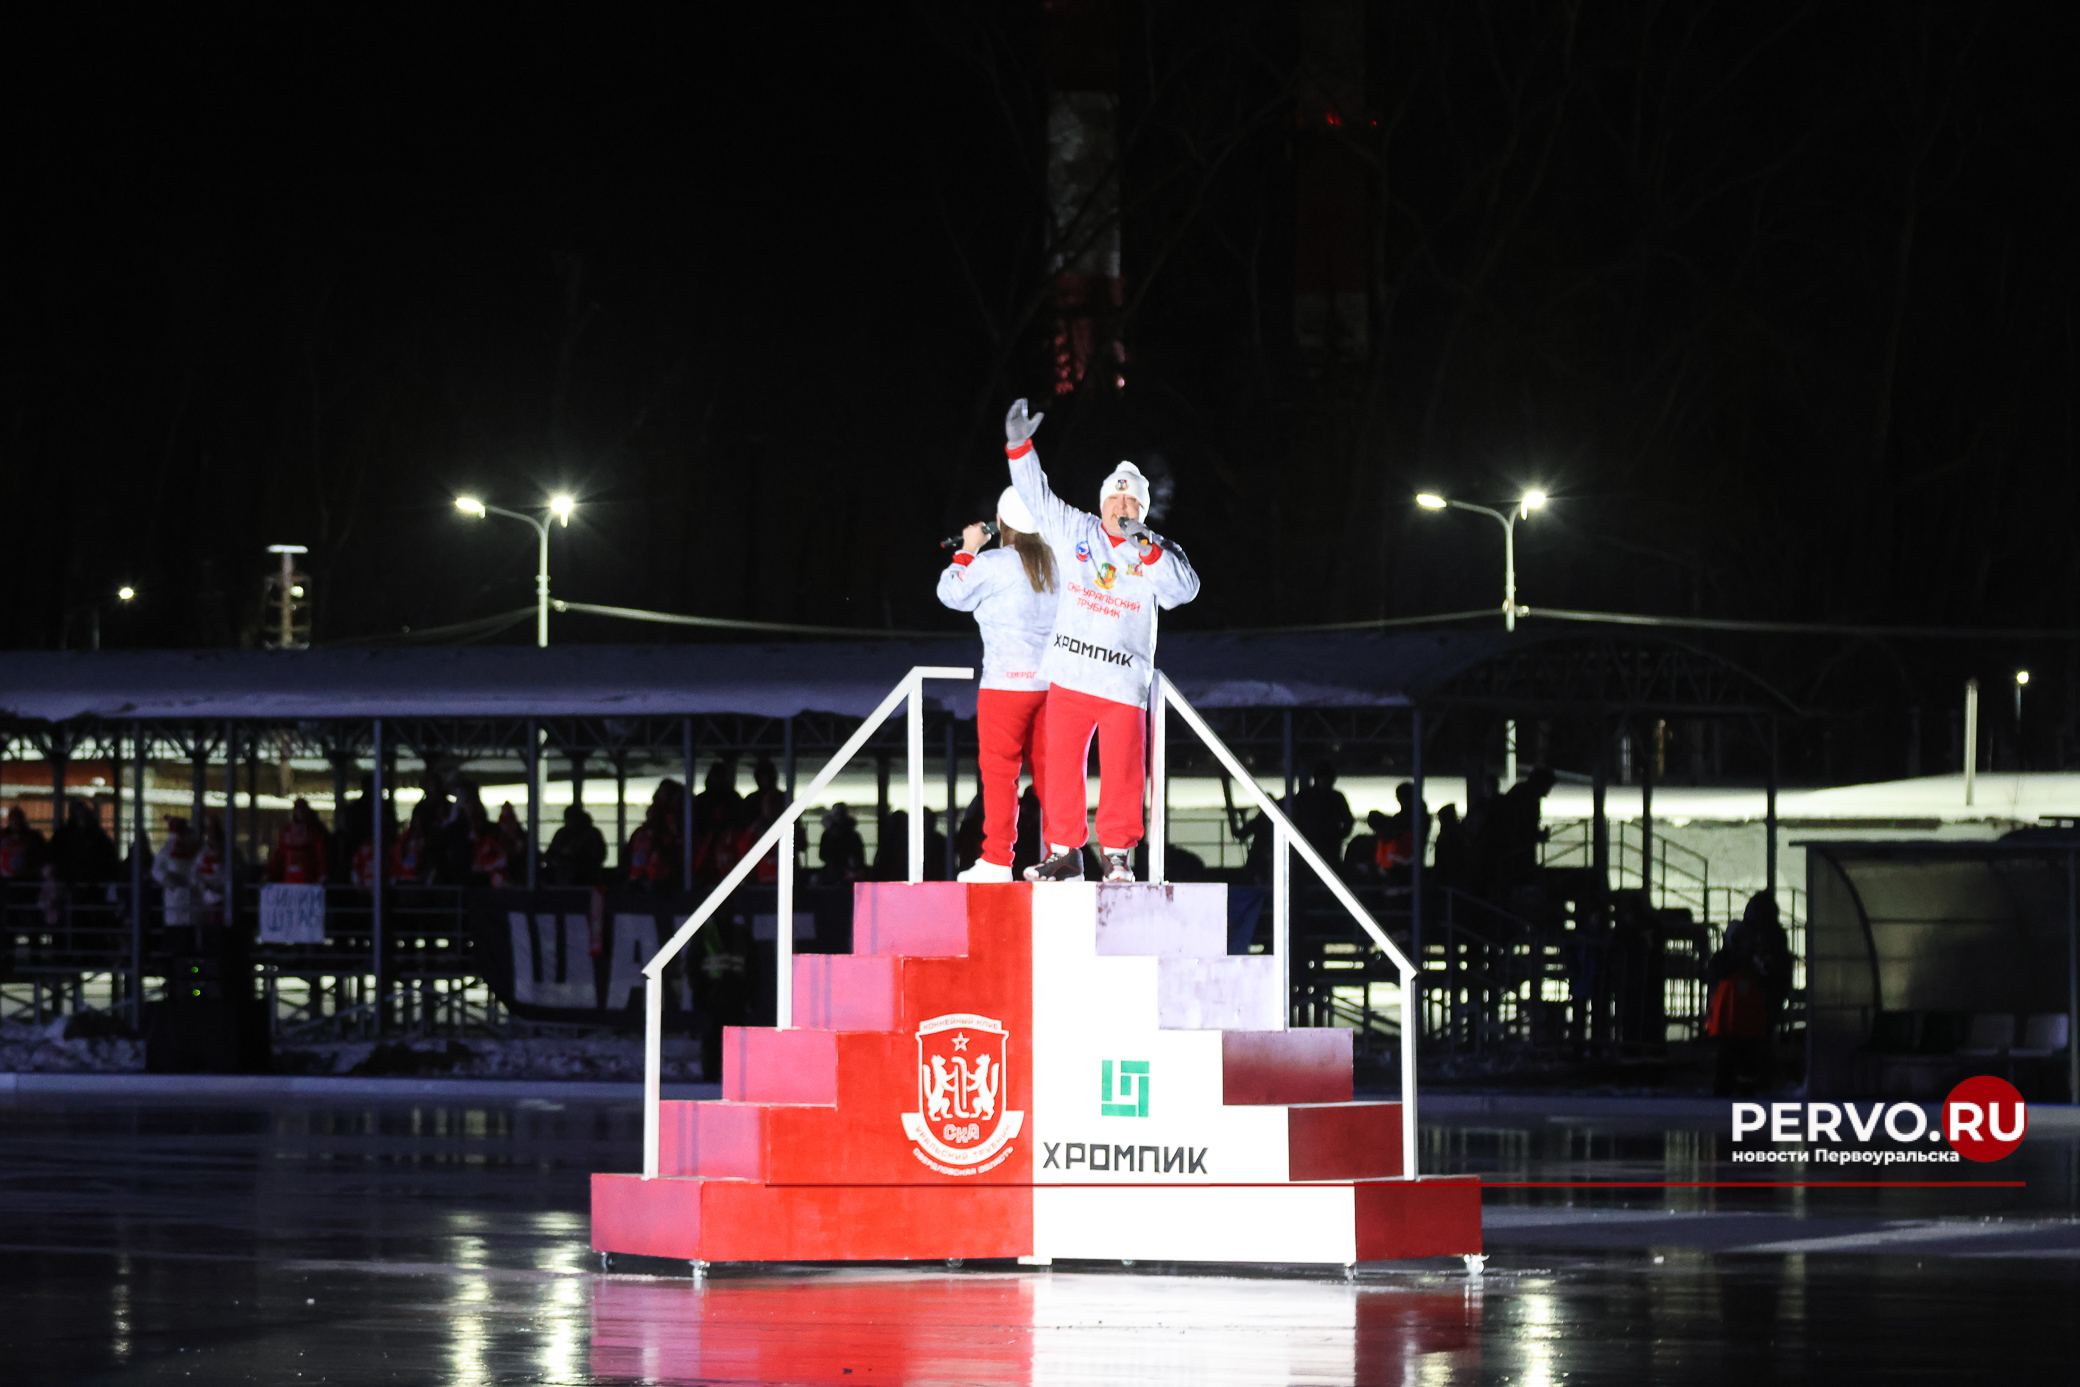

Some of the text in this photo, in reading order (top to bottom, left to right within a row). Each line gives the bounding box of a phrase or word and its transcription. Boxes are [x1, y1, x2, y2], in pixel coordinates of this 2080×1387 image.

[1077, 597, 1121, 619] ТРУБНИК
[1054, 633, 1134, 668] ХРОМПИК
[922, 1017, 999, 1030] ХОККЕЙНЫЙ КЛУБ
[915, 1124, 1012, 1161] УРАЛЬСКИЙ ТРУБНИК
[943, 1123, 980, 1144] СКА
[912, 1146, 1014, 1177] СВЕРДЛОВСКАЯ ОБЛАСТЬ
[1042, 1142, 1209, 1174] ХРОМПИК
